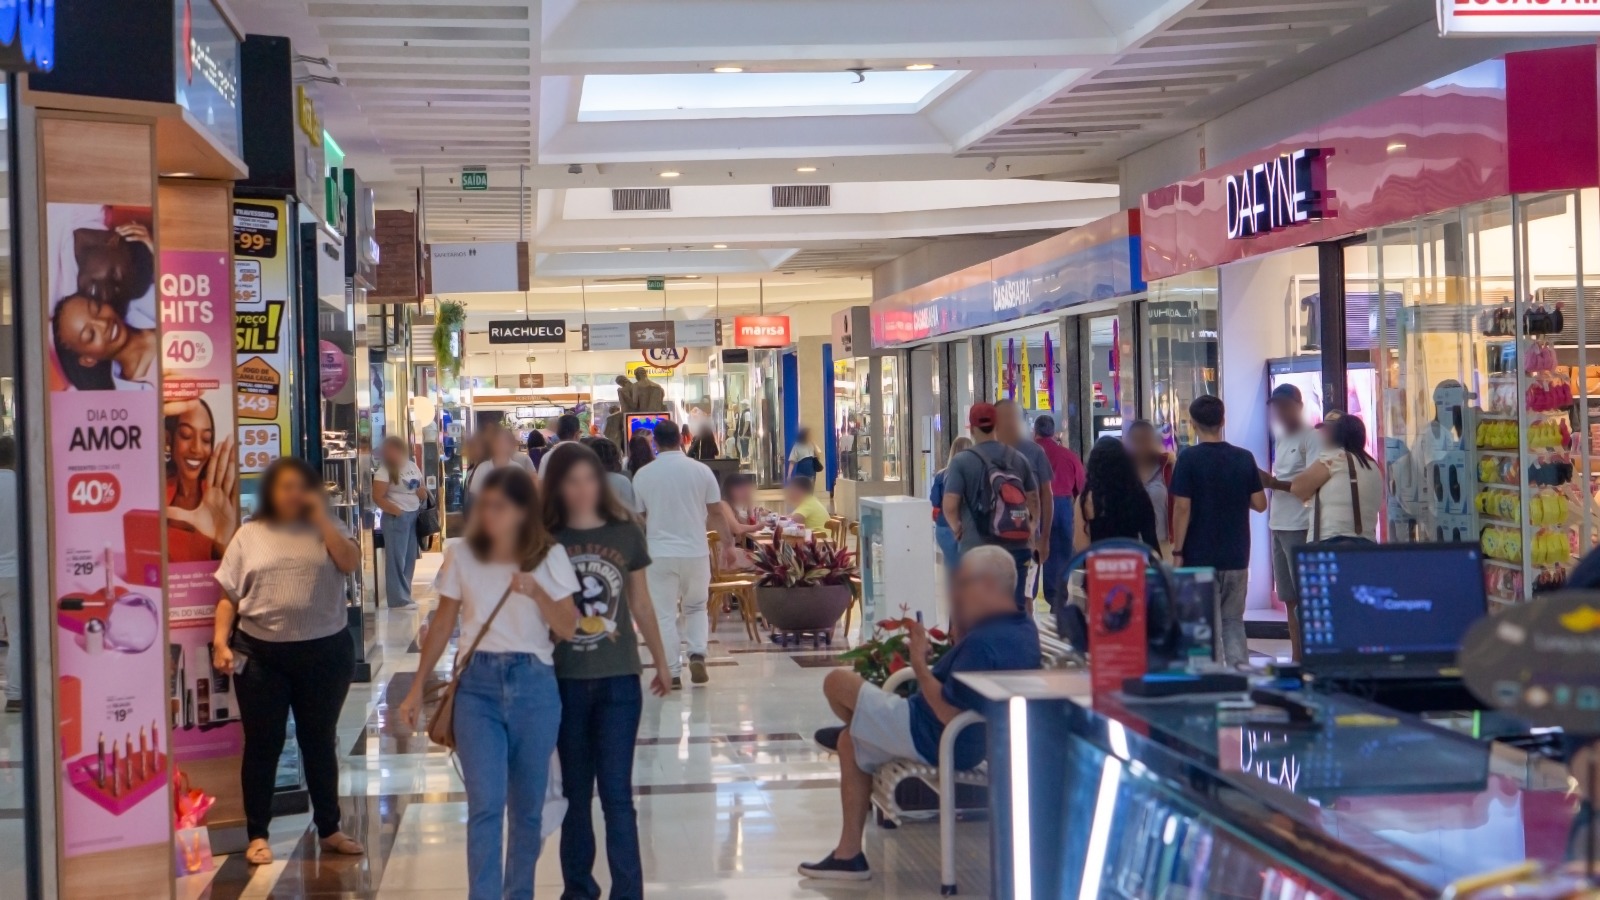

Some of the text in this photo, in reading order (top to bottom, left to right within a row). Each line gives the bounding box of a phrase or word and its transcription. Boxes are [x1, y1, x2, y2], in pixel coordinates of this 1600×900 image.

[462, 174, 487, 186] SAÍDA
[1226, 149, 1308, 239] DAFYNE
[240, 233, 264, 250] 99
[160, 273, 211, 297] QDB
[160, 300, 214, 323] HITS
[491, 326, 564, 337] RIACHUELO
[741, 326, 785, 336] marisa
[326, 352, 335, 363] 5
[649, 347, 680, 361] C&A
[87, 408, 128, 421] DIA DO
[69, 425, 142, 451] AMOR
[244, 429, 269, 446] 59
[72, 480, 115, 506] 40%
[74, 562, 94, 576] 219
[181, 609, 192, 617] DO
[114, 708, 127, 722] 19
